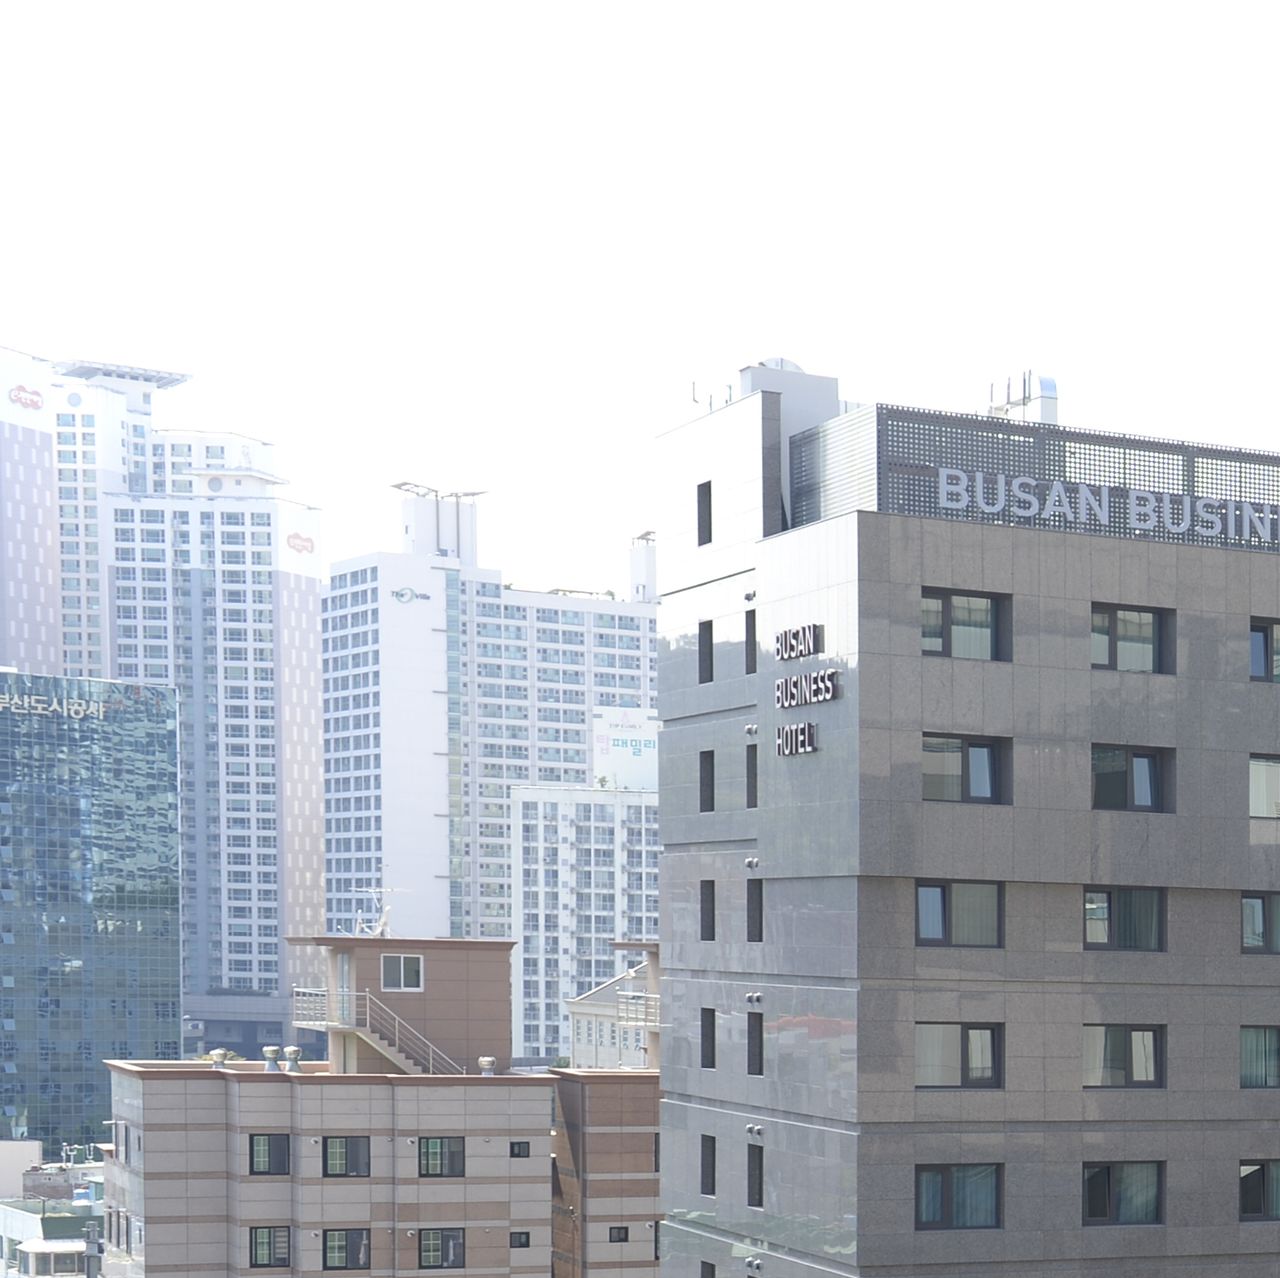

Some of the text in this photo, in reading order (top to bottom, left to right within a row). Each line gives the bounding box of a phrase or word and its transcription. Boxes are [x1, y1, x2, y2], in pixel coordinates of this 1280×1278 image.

[938, 468, 1110, 526] BUSAN
[775, 624, 814, 660] BUSAN
[775, 669, 835, 709] BUSINESS
[776, 721, 813, 756] HOTEL
